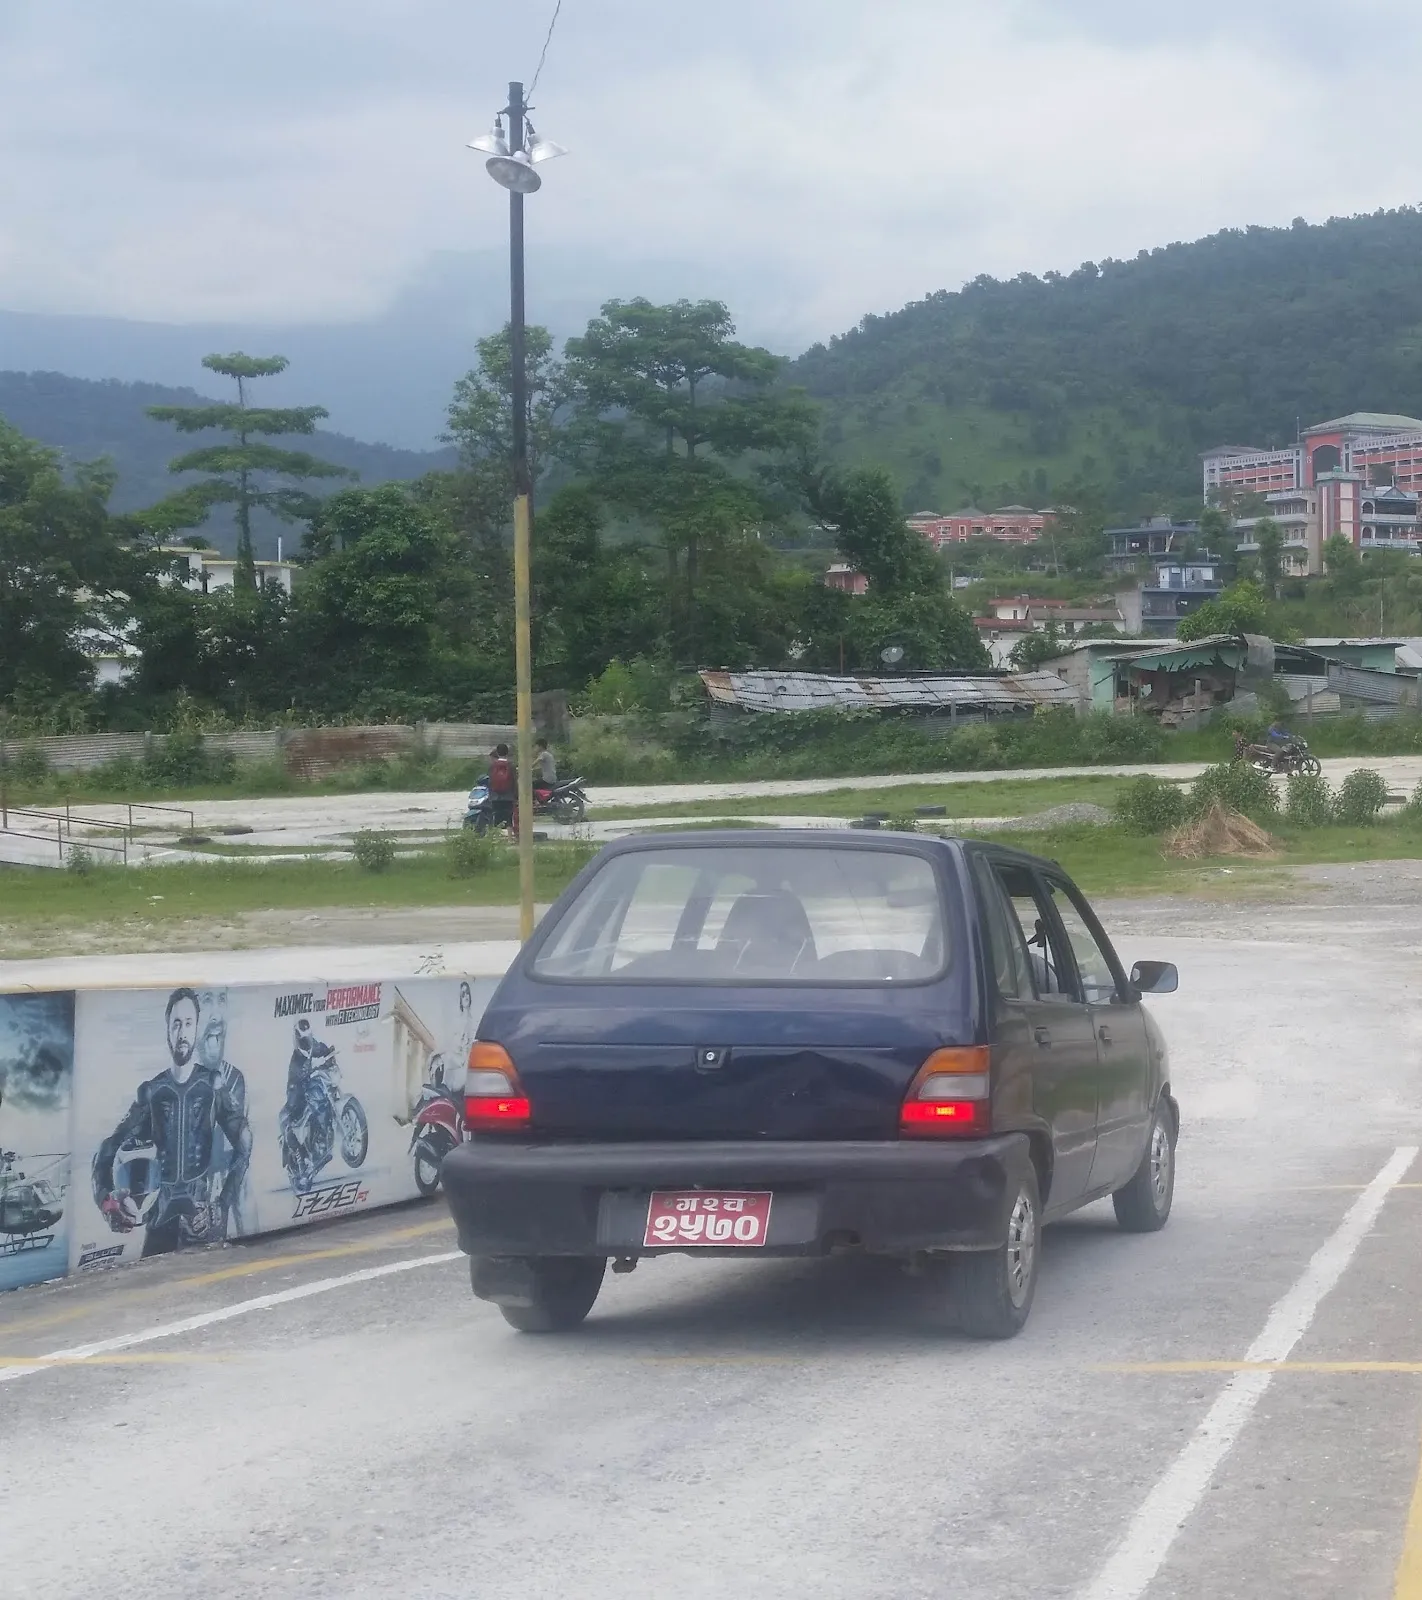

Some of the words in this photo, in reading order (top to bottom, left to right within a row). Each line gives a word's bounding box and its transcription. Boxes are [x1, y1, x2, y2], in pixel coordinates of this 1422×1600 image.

[274, 993, 313, 1018] MAXIMIZE
[312, 999, 327, 1012] YOUR
[345, 1004, 379, 1023] TECHNOLOGY
[652, 1215, 760, 1240] २५७०
